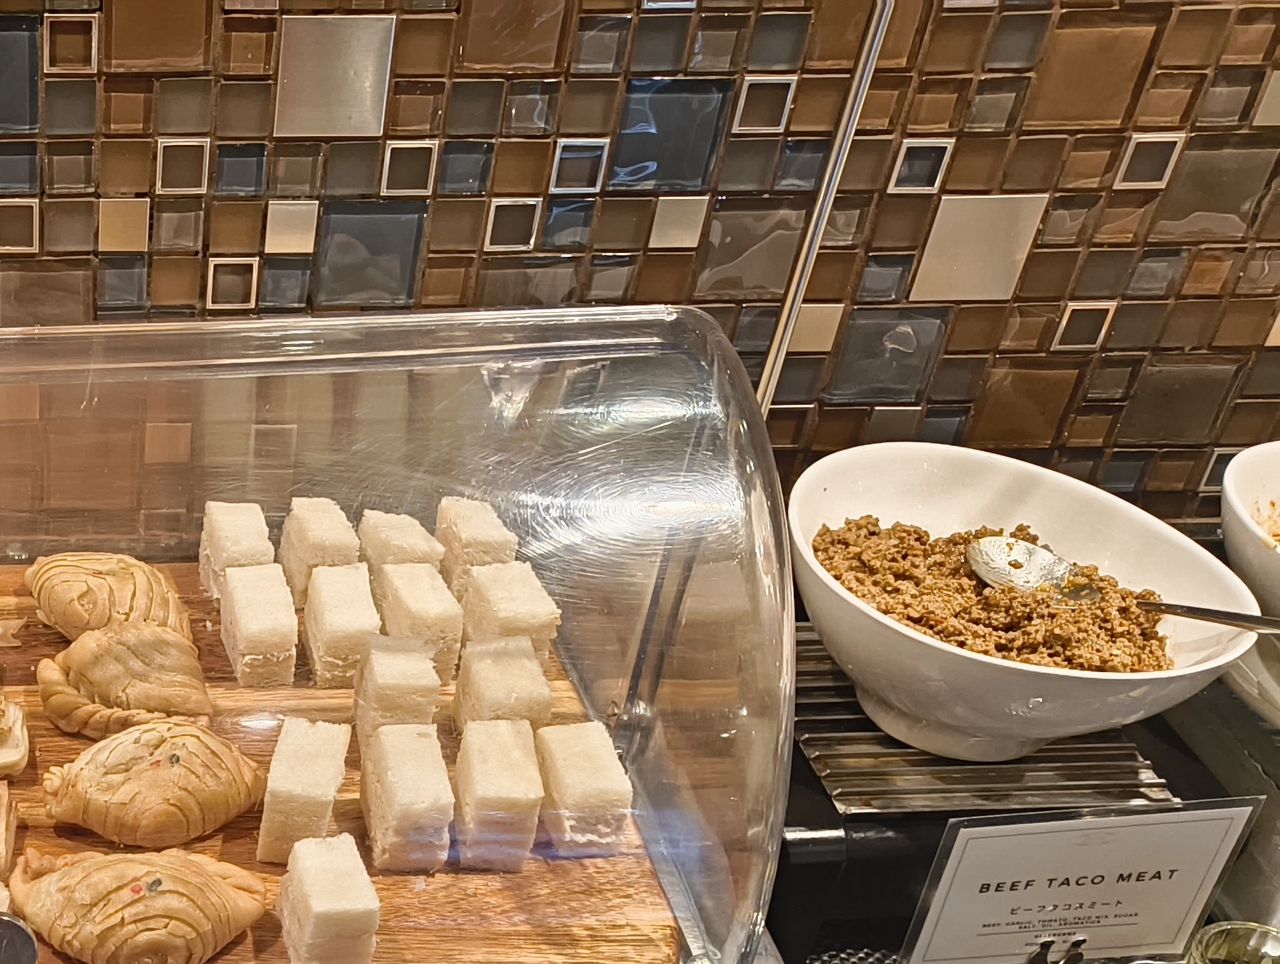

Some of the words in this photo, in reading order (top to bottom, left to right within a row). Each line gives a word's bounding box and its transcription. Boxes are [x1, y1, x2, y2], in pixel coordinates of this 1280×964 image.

[978, 879, 1036, 893] BEEF
[1046, 874, 1105, 889] TACO
[1116, 869, 1178, 884] MEAT
